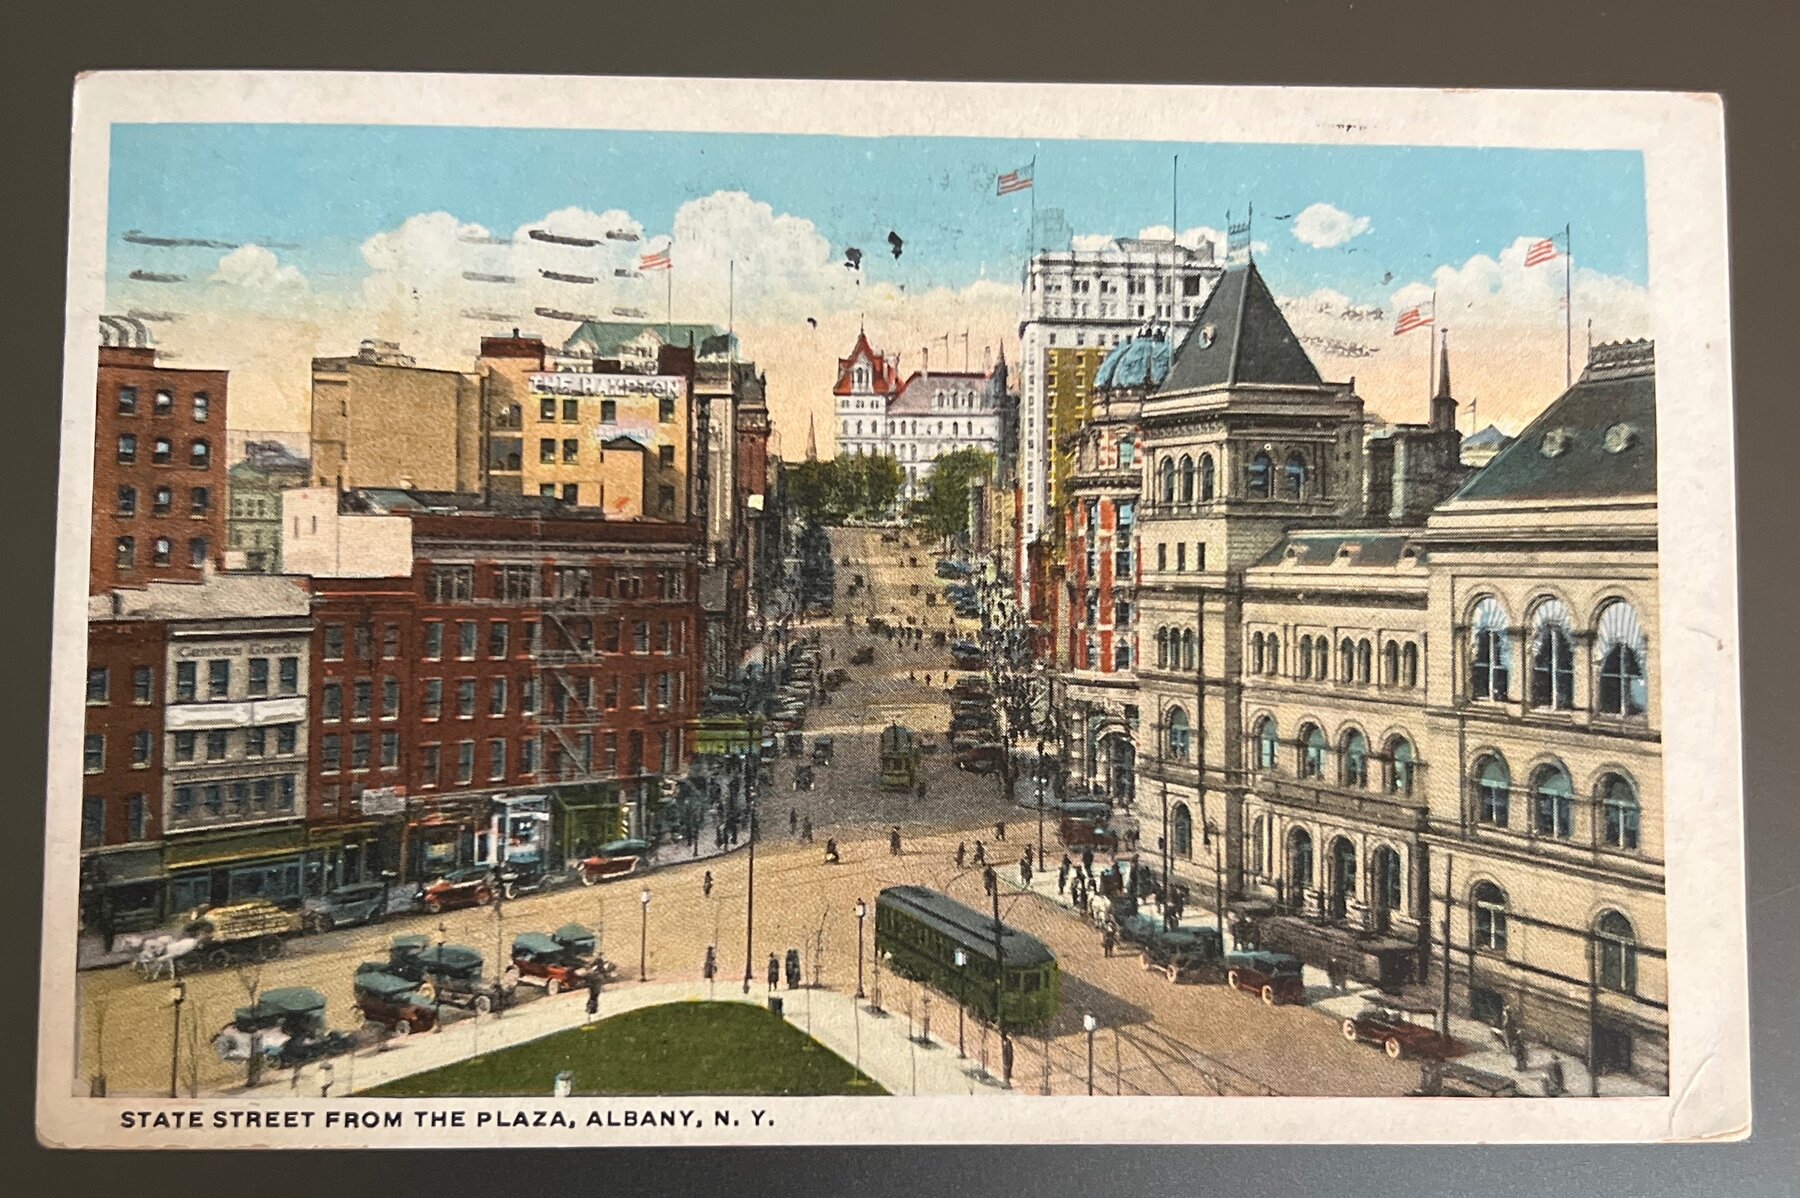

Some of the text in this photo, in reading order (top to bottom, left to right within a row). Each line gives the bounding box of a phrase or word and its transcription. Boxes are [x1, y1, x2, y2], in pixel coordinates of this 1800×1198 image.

[581, 376, 682, 399] HAMPTON
[121, 1110, 774, 1130] STATE STREET FROM THE PLAZA, ALBANY, N. Y.
